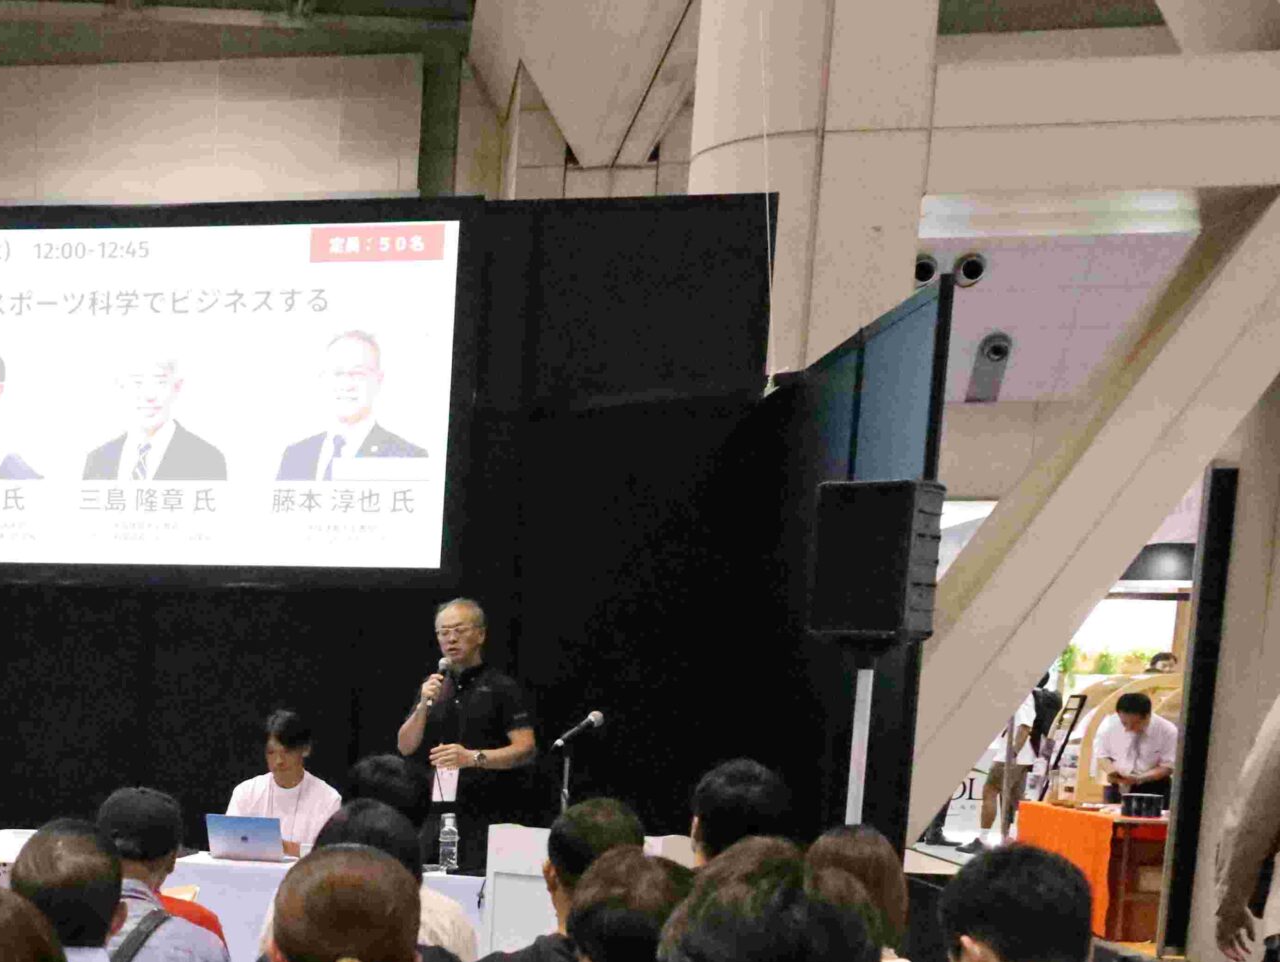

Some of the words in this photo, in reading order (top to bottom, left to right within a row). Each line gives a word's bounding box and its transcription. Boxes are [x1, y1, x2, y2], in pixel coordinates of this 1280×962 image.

[32, 239, 151, 261] 12:00-12:45
[2, 486, 26, 511] 氏
[79, 487, 128, 513] 三島
[135, 487, 185, 513] 隆章
[193, 487, 217, 513] 氏
[271, 488, 323, 514] 藤本
[331, 488, 382, 514] 淳也
[390, 488, 416, 514] 氏
